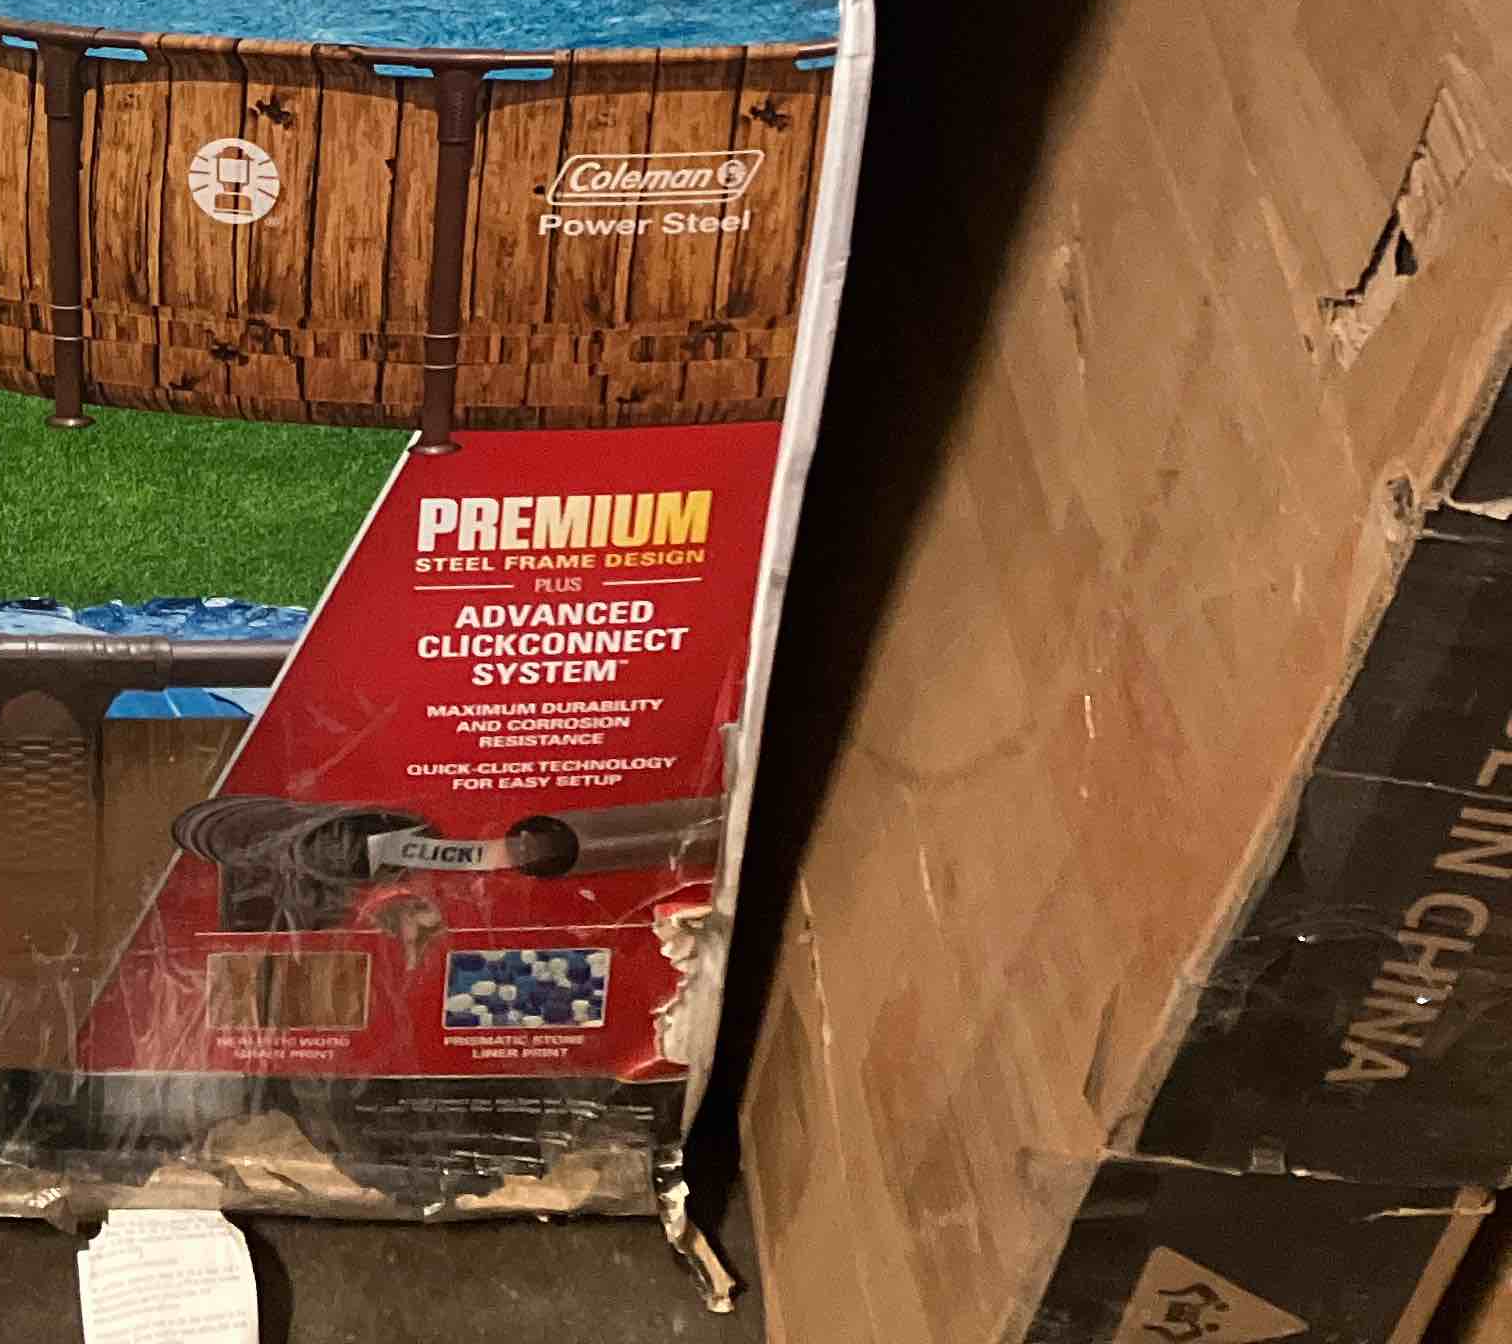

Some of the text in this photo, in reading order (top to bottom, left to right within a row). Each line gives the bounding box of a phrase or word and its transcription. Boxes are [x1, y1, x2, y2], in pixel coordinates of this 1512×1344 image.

[569, 159, 714, 193] Coleman
[537, 208, 752, 237] Power Steel
[416, 490, 713, 553] PREMIUM
[414, 549, 706, 574] STEEL FRAME DESIGN
[533, 577, 583, 594] PLUS
[454, 600, 655, 630] ADVANCED
[416, 627, 691, 659] CLICKCONNECT
[426, 697, 664, 719] MAXIMUM DURABILITY
[455, 715, 632, 734] AND CORROSION
[478, 733, 606, 749] RESISTANCE
[405, 756, 678, 777] QUICK-CLICK TECHNOLOGY
[451, 773, 624, 791] FOR EASY SETUP
[399, 841, 484, 865] CLICK!
[1324, 892, 1489, 1086] CHINA
[471, 1047, 569, 1060] LINER PRINT
